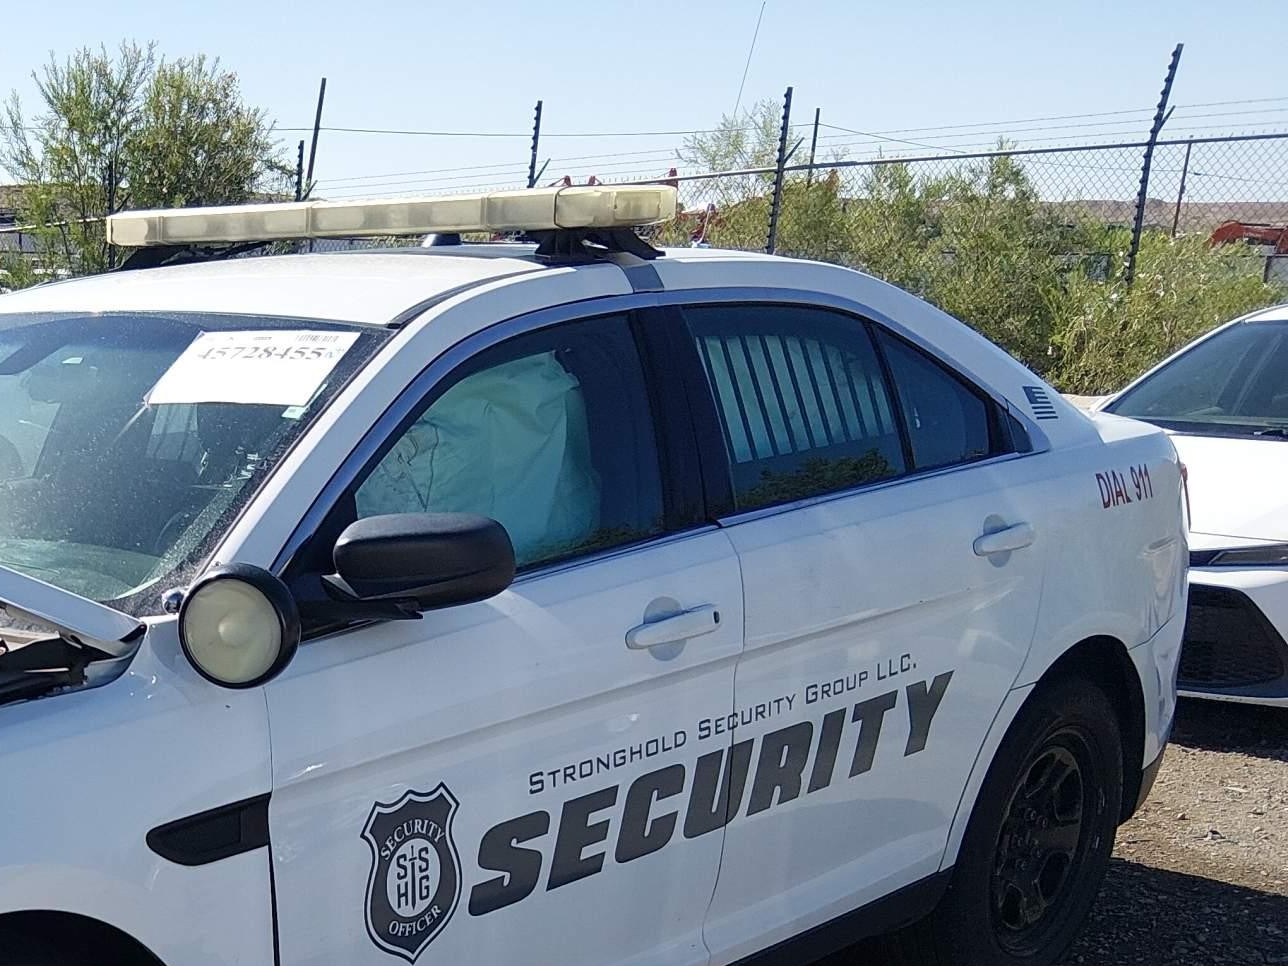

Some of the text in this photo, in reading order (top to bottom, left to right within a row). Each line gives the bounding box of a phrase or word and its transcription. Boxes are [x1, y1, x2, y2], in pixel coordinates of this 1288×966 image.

[200, 346, 327, 359] 45728455
[1096, 463, 1153, 508] DIAL 911
[876, 653, 917, 681] LLC.
[467, 670, 955, 917] SECURITY
[381, 818, 446, 861] SECURITY
[389, 904, 442, 937] OFFICER
